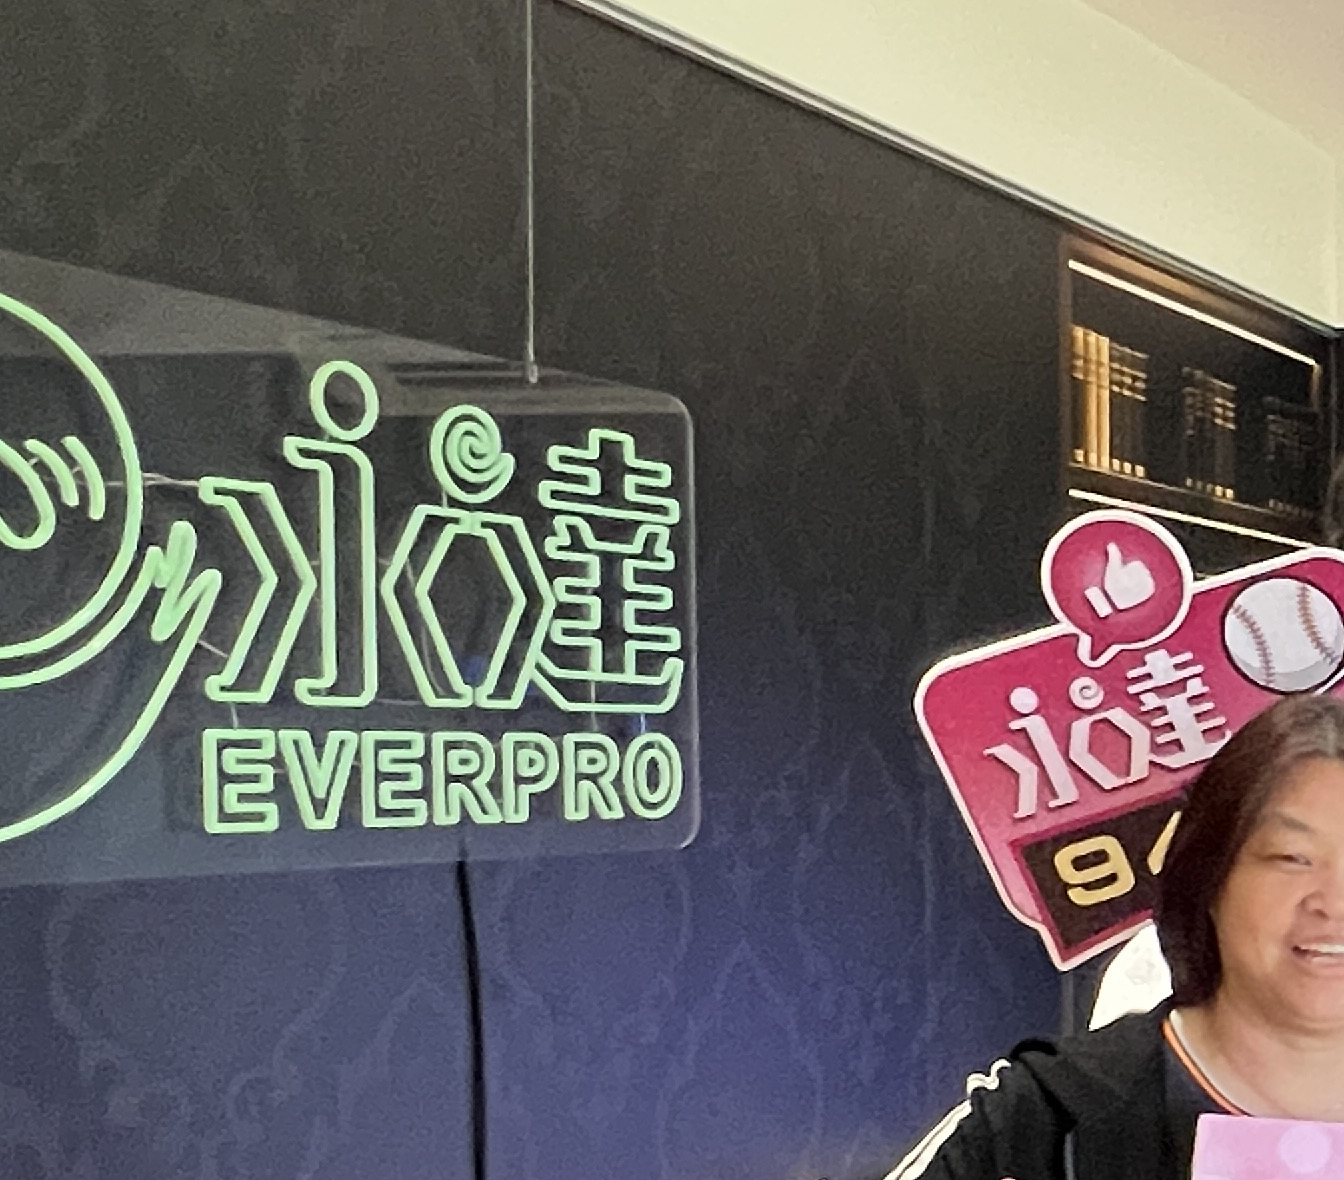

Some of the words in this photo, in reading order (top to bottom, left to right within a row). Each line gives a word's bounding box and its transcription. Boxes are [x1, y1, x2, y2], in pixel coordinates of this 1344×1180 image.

[200, 361, 684, 713] 永達
[203, 728, 684, 834] EVERPRO
[983, 649, 1232, 818] 永達
